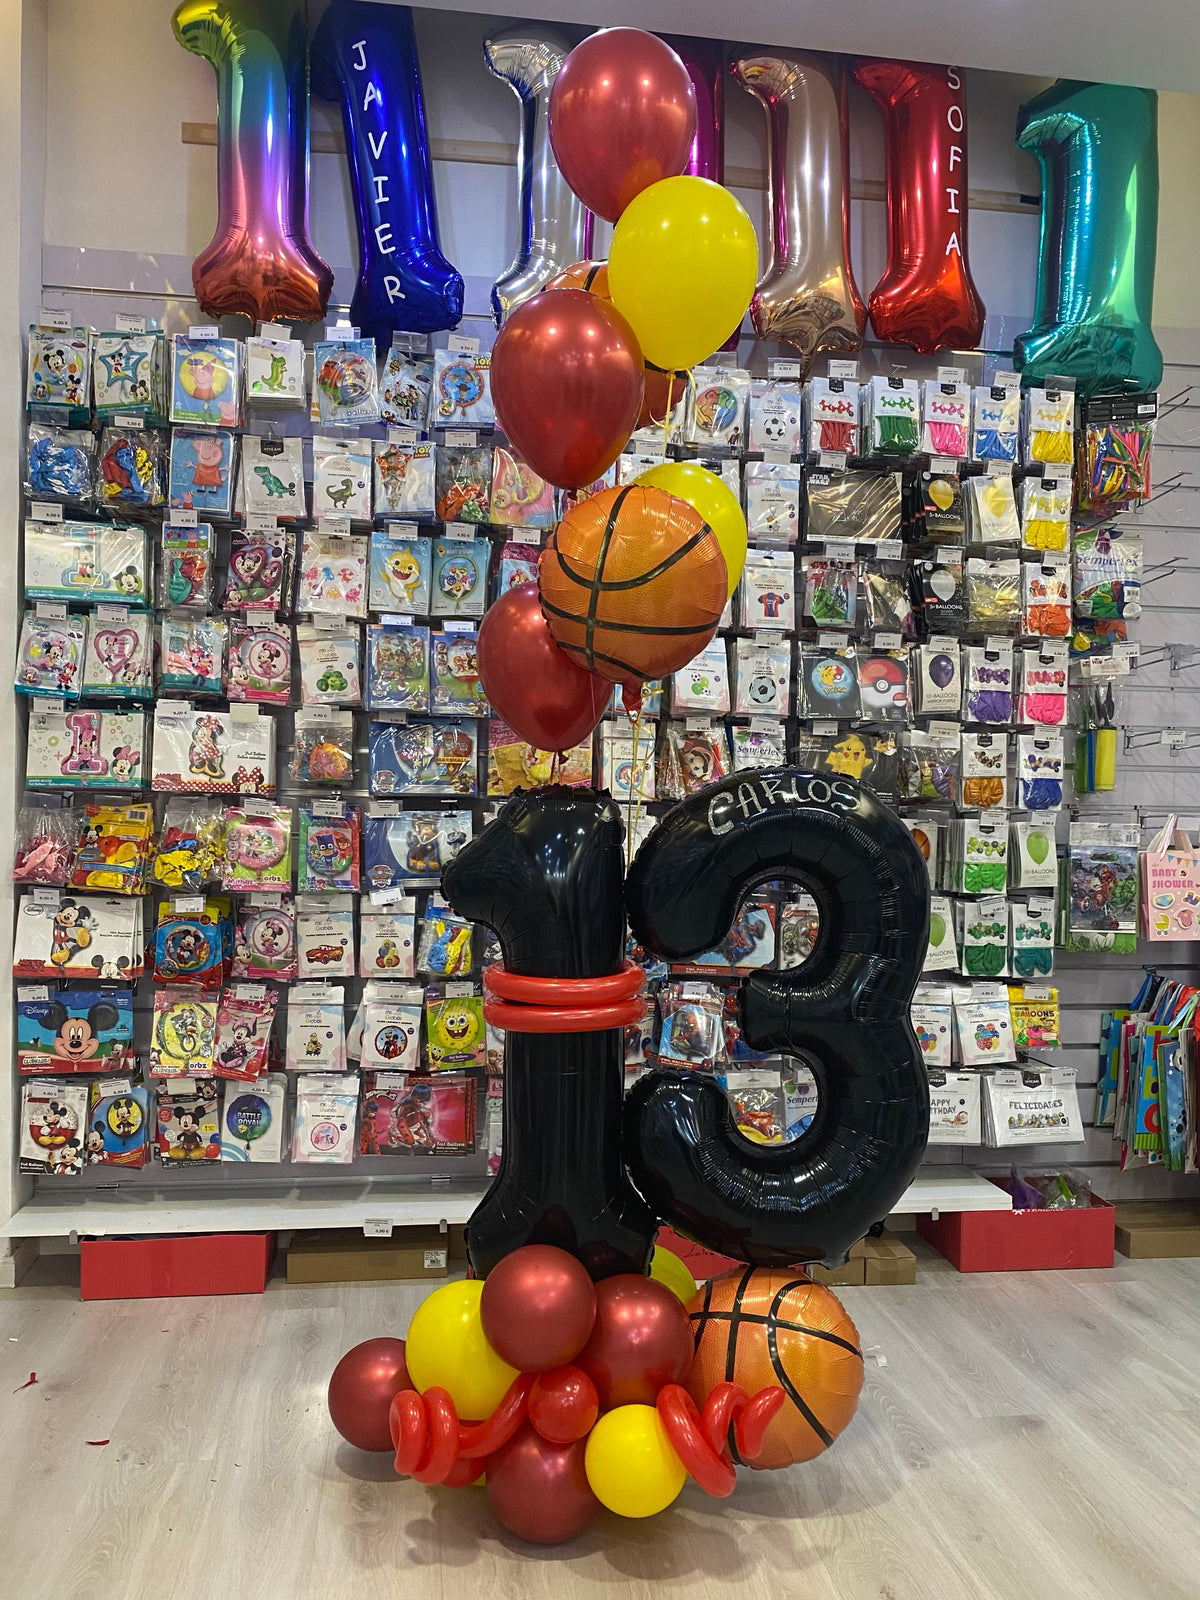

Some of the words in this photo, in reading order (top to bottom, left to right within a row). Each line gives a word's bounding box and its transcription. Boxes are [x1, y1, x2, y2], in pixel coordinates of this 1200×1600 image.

[946, 66, 964, 256] SOFIA
[352, 40, 406, 304] JAVIER
[474, 357, 491, 366] TOY
[413, 445, 431, 454] TOY
[707, 777, 861, 836] CARLOS
[1151, 869, 1177, 877] BABY
[1152, 880, 1194, 889] SHOWER
[24, 1005, 48, 1016] Disney
[189, 1061, 207, 1069] orbz
[930, 1098, 951, 1107] APPY
[1009, 1099, 1063, 1110] FELICIDADES
[237, 1112, 262, 1121] BATTLE
